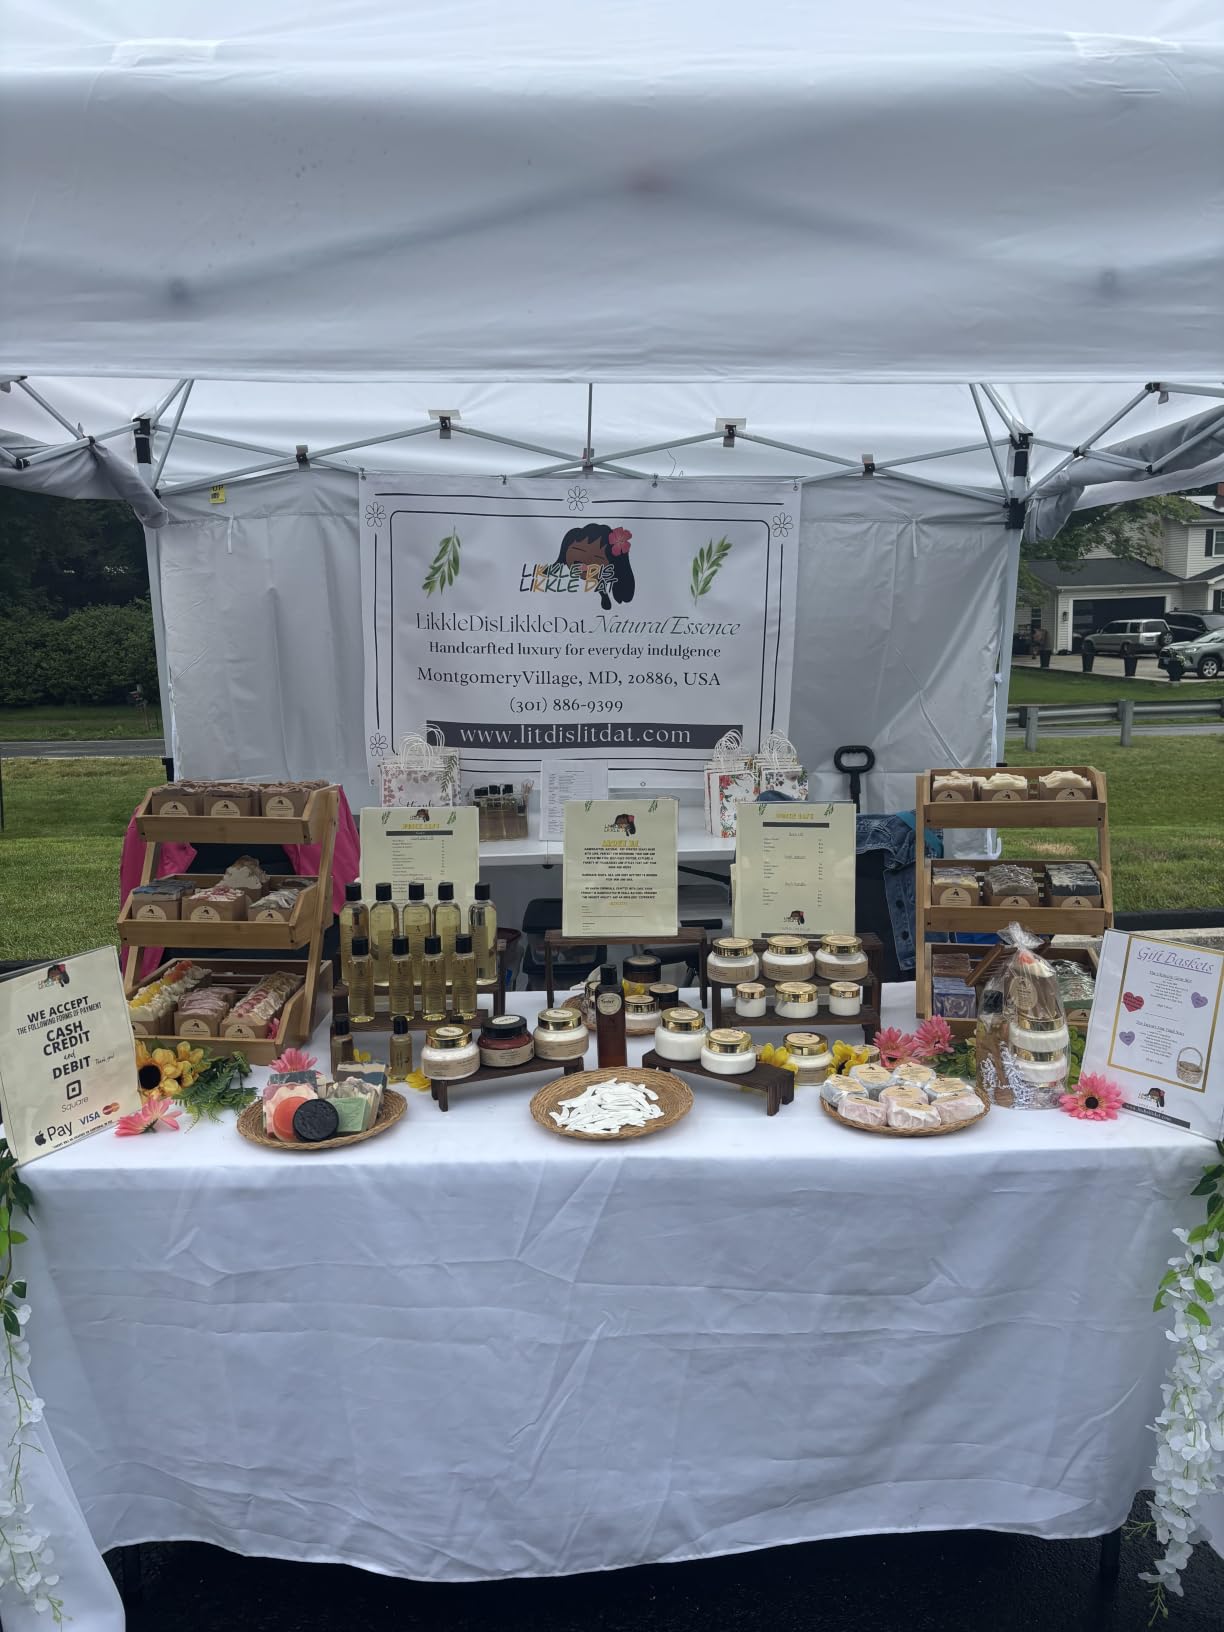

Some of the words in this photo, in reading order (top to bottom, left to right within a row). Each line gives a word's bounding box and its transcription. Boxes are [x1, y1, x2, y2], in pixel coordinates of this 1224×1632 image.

[521, 563, 582, 578] LIKKLE
[586, 563, 615, 579] DIS
[519, 578, 580, 592] LIKKLE
[584, 578, 618, 593] DAT
[416, 611, 586, 634] LikkleDisLikkleDat
[588, 614, 672, 634] Natural
[669, 616, 741, 636] Essence
[429, 641, 514, 655] Handcarfted
[518, 642, 562, 659] luxury
[565, 643, 585, 656] for
[588, 644, 644, 659] everyday
[648, 644, 721, 660] indulgence
[587, 670, 622, 686] MD,
[628, 672, 678, 687] 20886,
[683, 672, 721, 686] USA
[510, 696, 547, 713] (301)
[553, 699, 623, 713] 886-9399
[460, 724, 691, 744] www.litdislitdat.com
[1137, 945, 1165, 963] Gift
[1164, 951, 1214, 973] Baskets
[17, 1026, 27, 1036] THE
[28, 1017, 56, 1032] FOLLOWING
[56, 1011, 73, 1023] FORMS
[73, 1009, 80, 1017] OF
[80, 1002, 102, 1015] PAYMENT
[27, 1010, 46, 1024] WE
[48, 996, 89, 1018] ACCEPT
[46, 1020, 83, 1042] CASH
[43, 1030, 91, 1056] CREDIT
[63, 1048, 76, 1060] and
[52, 1055, 91, 1080] DEBIT
[61, 1096, 89, 1113] Square
[47, 1121, 72, 1142] Pay
[78, 1111, 101, 1125] VISA
